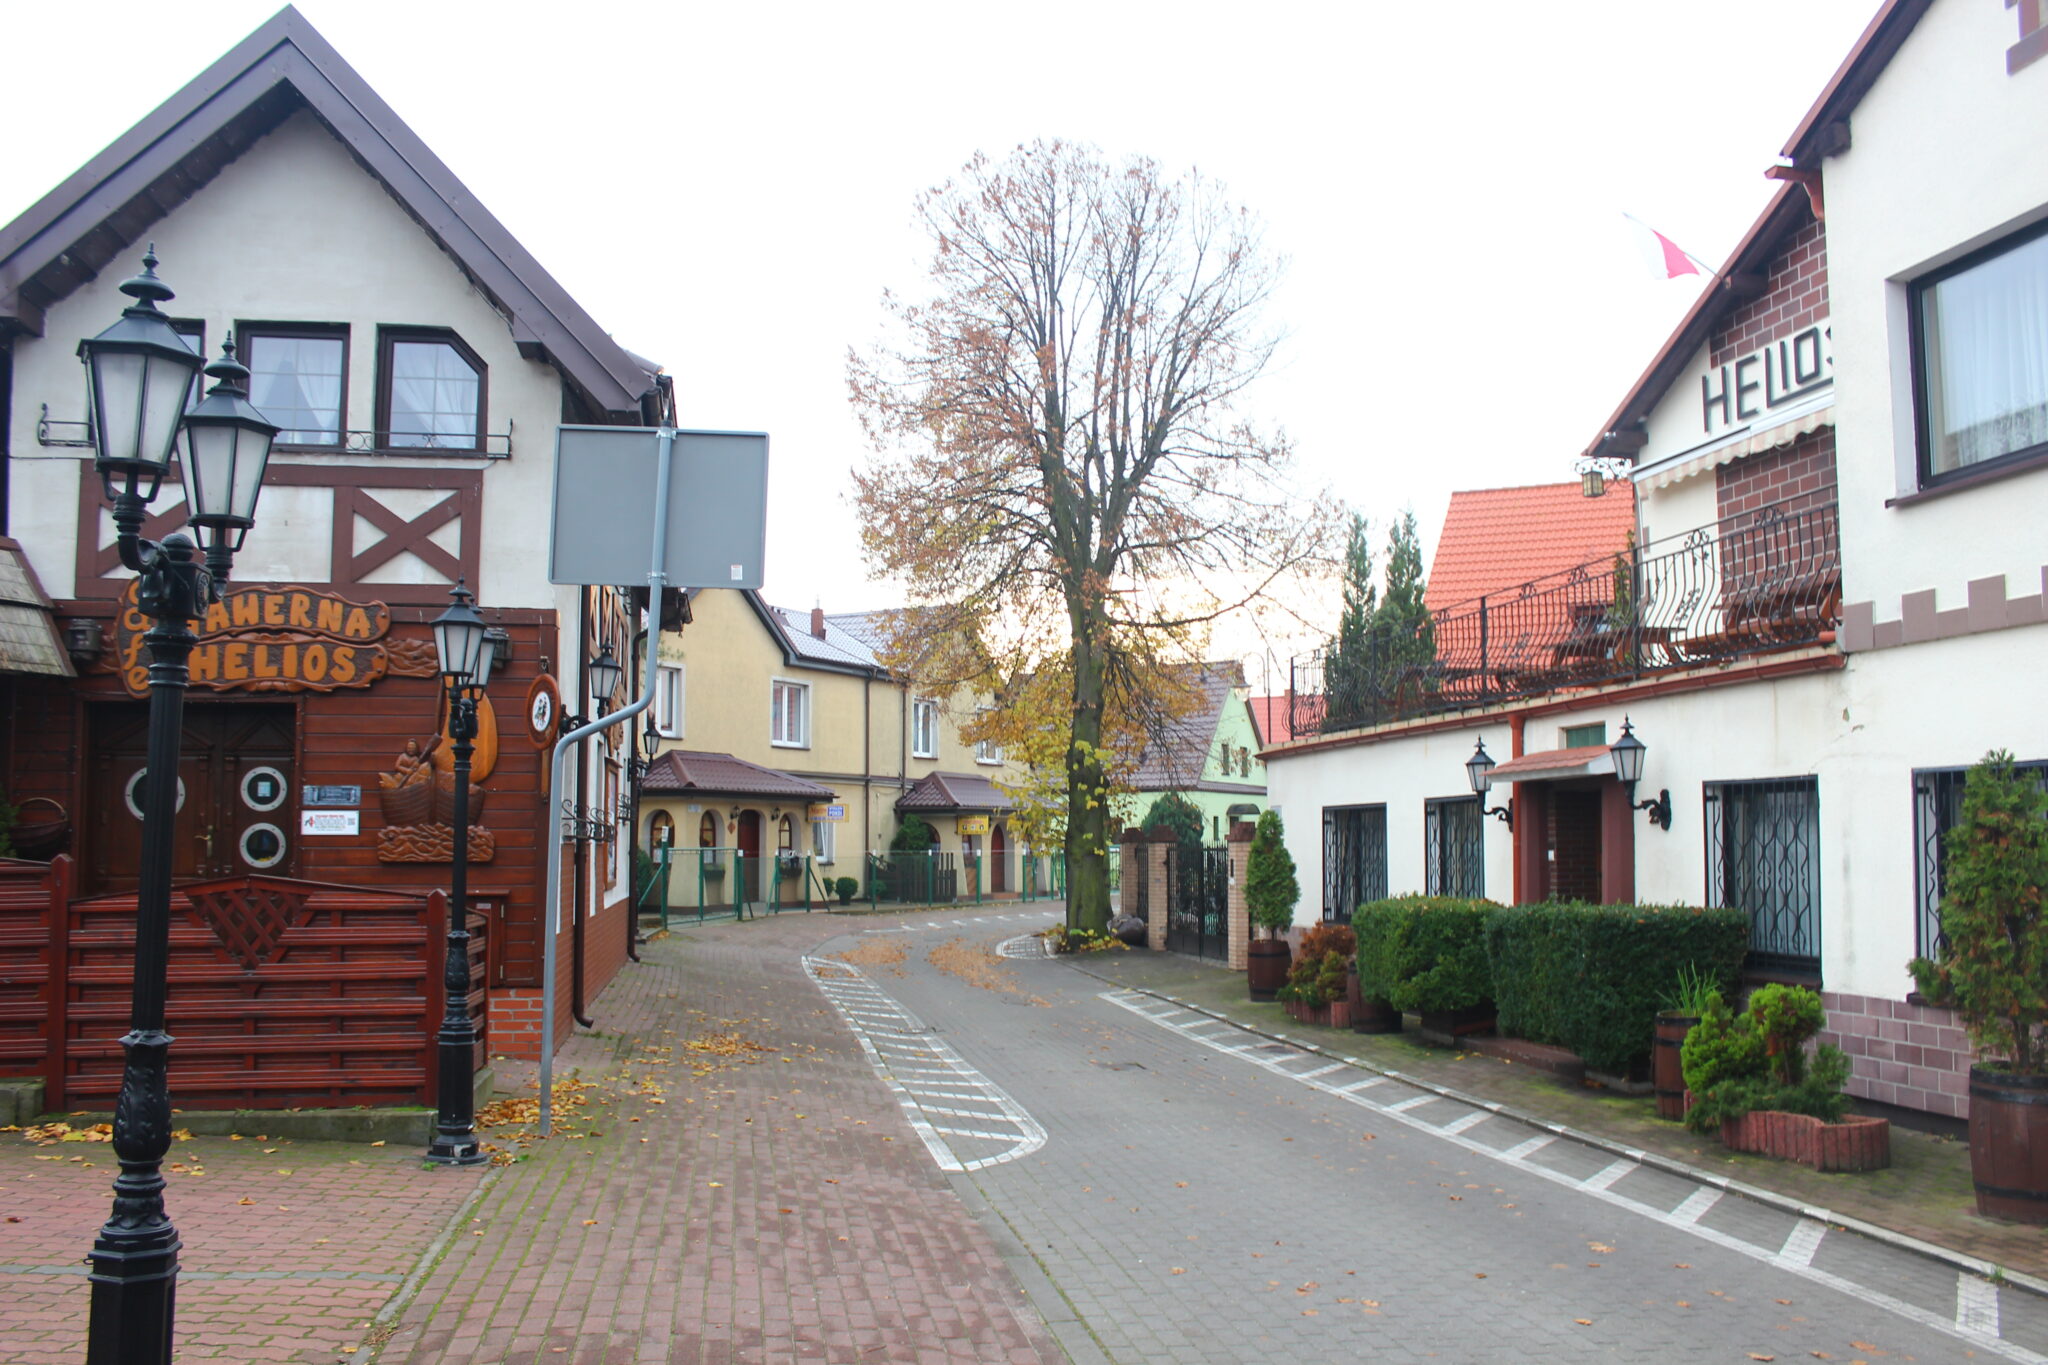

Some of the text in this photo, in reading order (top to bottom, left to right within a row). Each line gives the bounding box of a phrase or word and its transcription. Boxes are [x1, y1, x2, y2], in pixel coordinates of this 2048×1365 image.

[1701, 326, 1833, 433] HELIO
[188, 592, 371, 638] AWERNA
[187, 642, 356, 683] HELIOS
